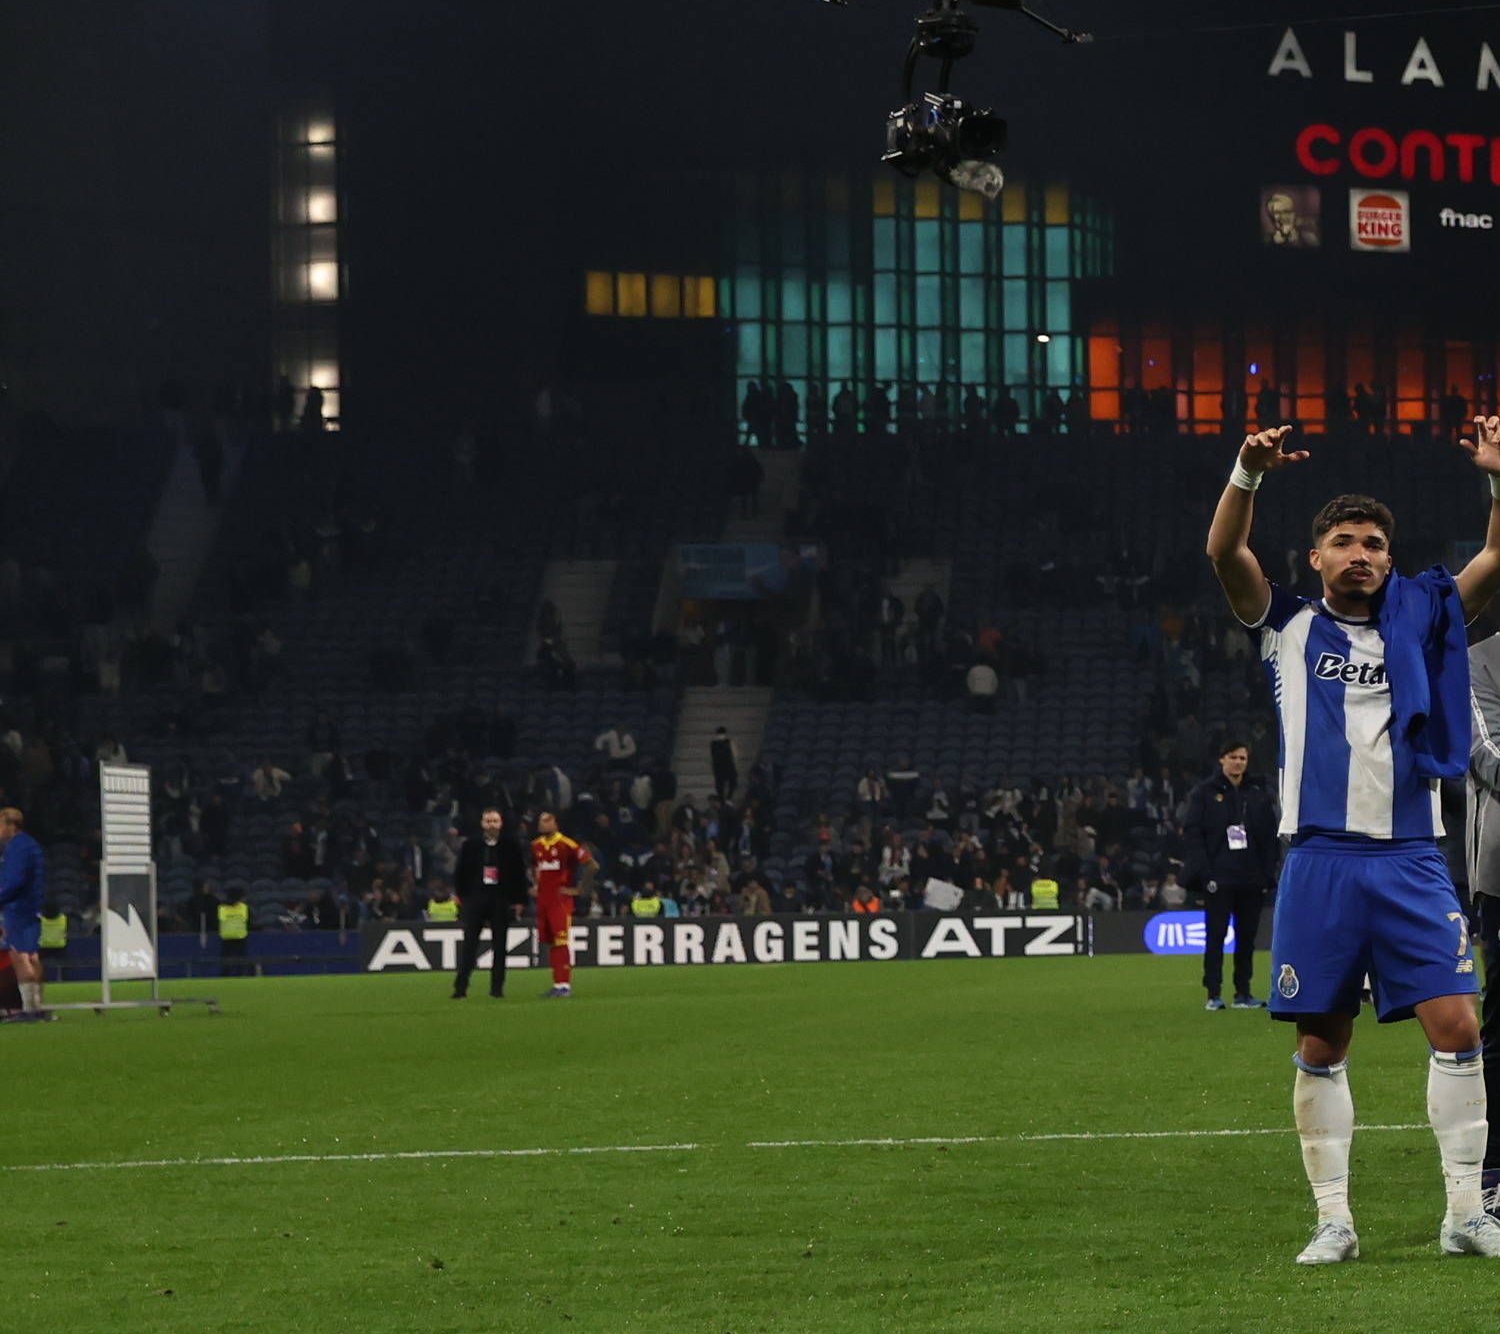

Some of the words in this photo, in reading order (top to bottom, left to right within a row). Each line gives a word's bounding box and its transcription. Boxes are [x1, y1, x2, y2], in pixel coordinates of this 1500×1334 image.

[1357, 222, 1403, 237] KING
[1440, 208, 1493, 230] fnac
[1315, 651, 1389, 685] Beta
[569, 917, 900, 966] FERRAGENS
[921, 915, 1084, 958] ATZ!
[1446, 911, 1468, 957] 7
